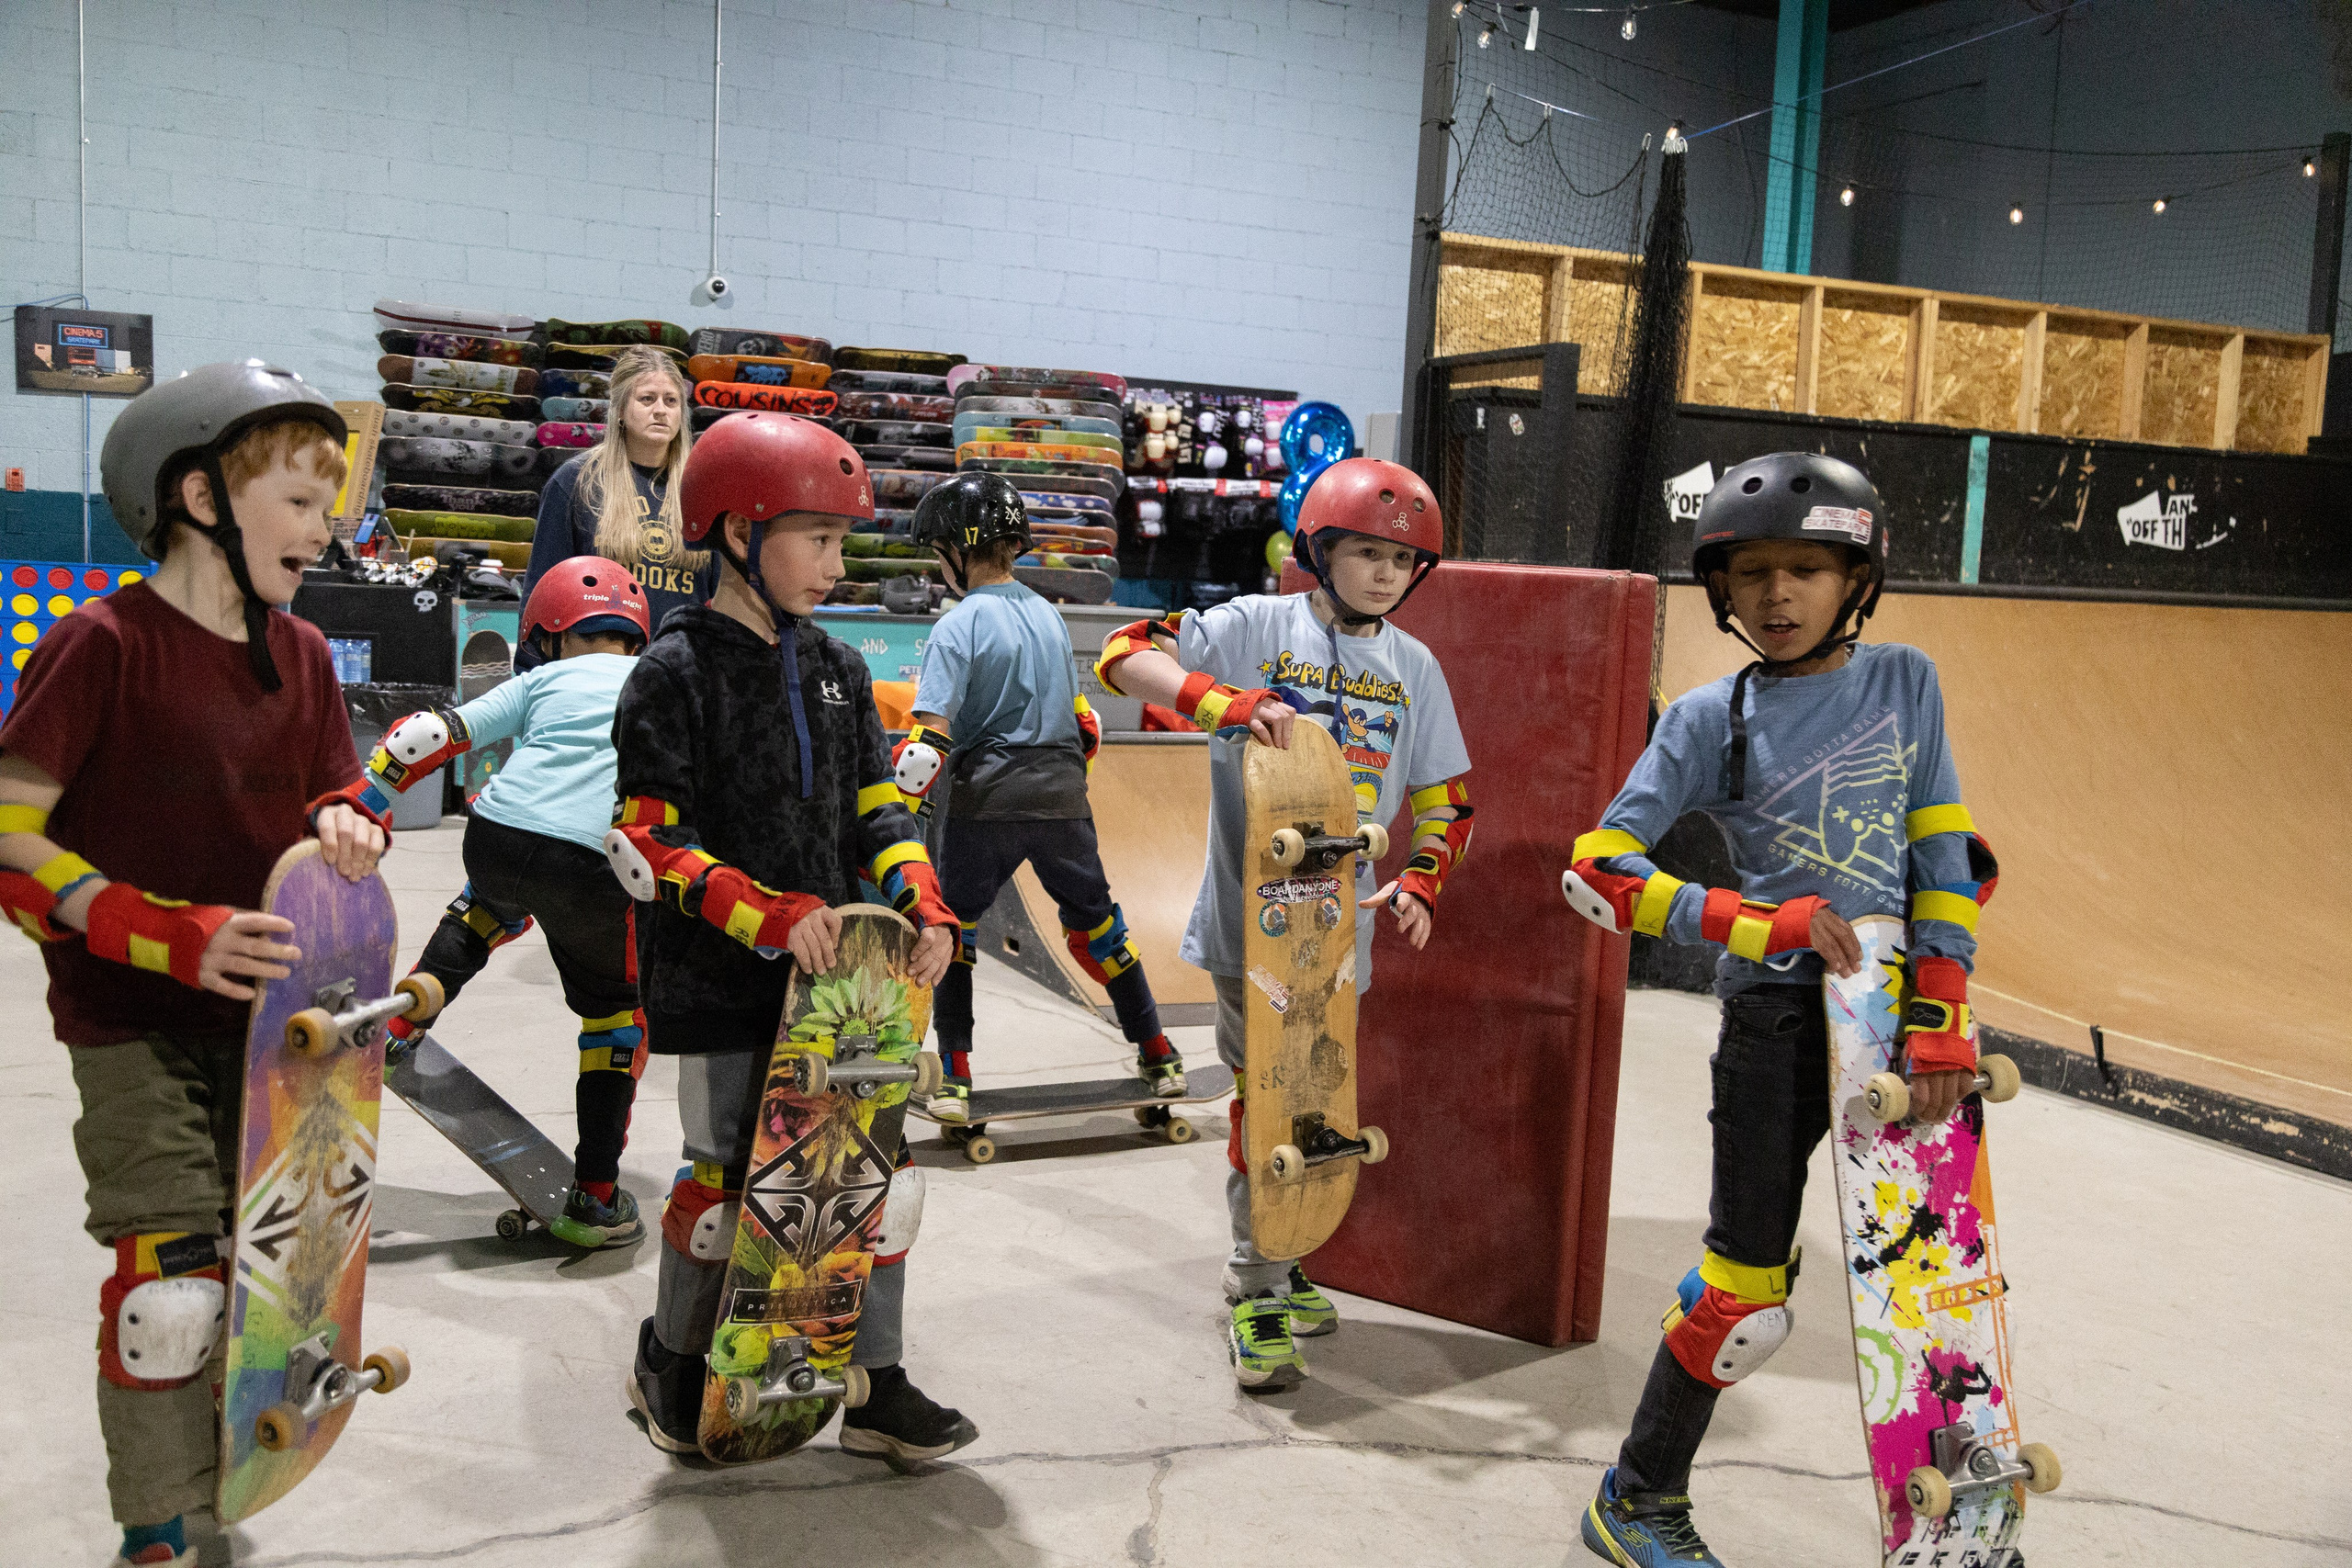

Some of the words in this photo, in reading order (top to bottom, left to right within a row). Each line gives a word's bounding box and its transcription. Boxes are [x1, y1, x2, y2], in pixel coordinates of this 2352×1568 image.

[63, 327, 94, 338] CINEMA
[65, 337, 101, 345] SKATEPARK
[699, 386, 812, 412] COUSINS
[354, 439, 376, 514] skateboarding
[1813, 506, 1860, 521] CINEMA
[1803, 517, 1865, 532] SKATEPARK
[965, 526, 979, 546] 17
[583, 593, 610, 602] triple
[622, 599, 642, 613] eight
[860, 637, 889, 655] AND
[1802, 733, 1850, 765] GOTTA
[1768, 843, 1828, 877] GAMERS
[1768, 1274, 1783, 1295] L
